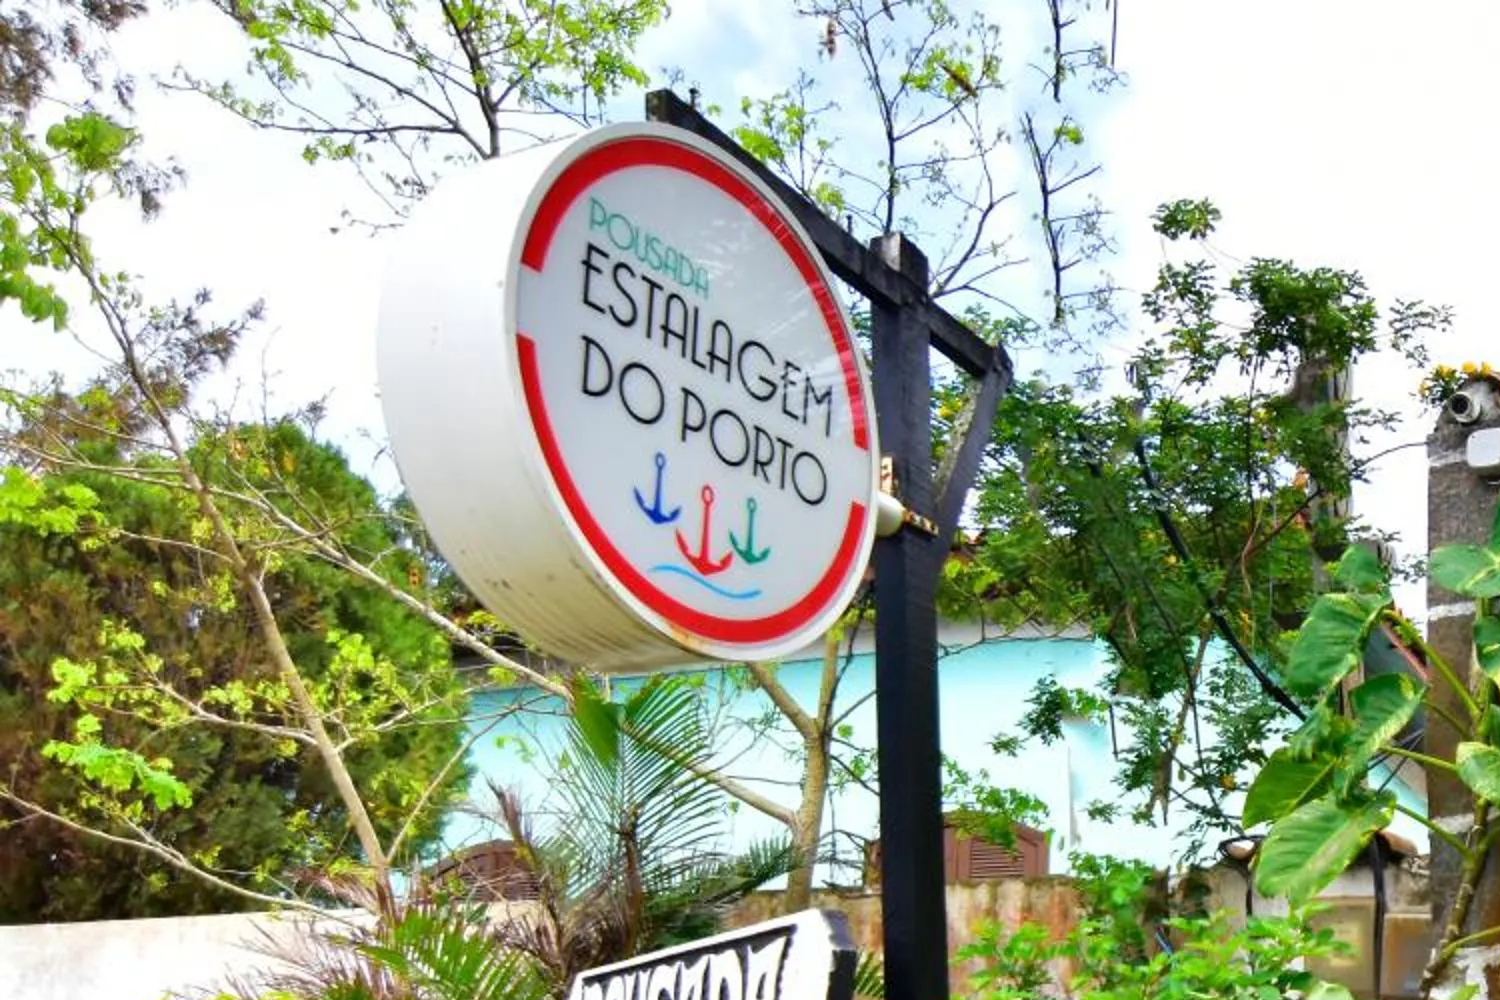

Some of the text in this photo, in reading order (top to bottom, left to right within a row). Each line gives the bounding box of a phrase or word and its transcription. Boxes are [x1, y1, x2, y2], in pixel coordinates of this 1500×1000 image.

[588, 198, 711, 300] POUSADA
[580, 242, 833, 438] ESTALAGEM
[580, 334, 828, 506] DO PORTO
